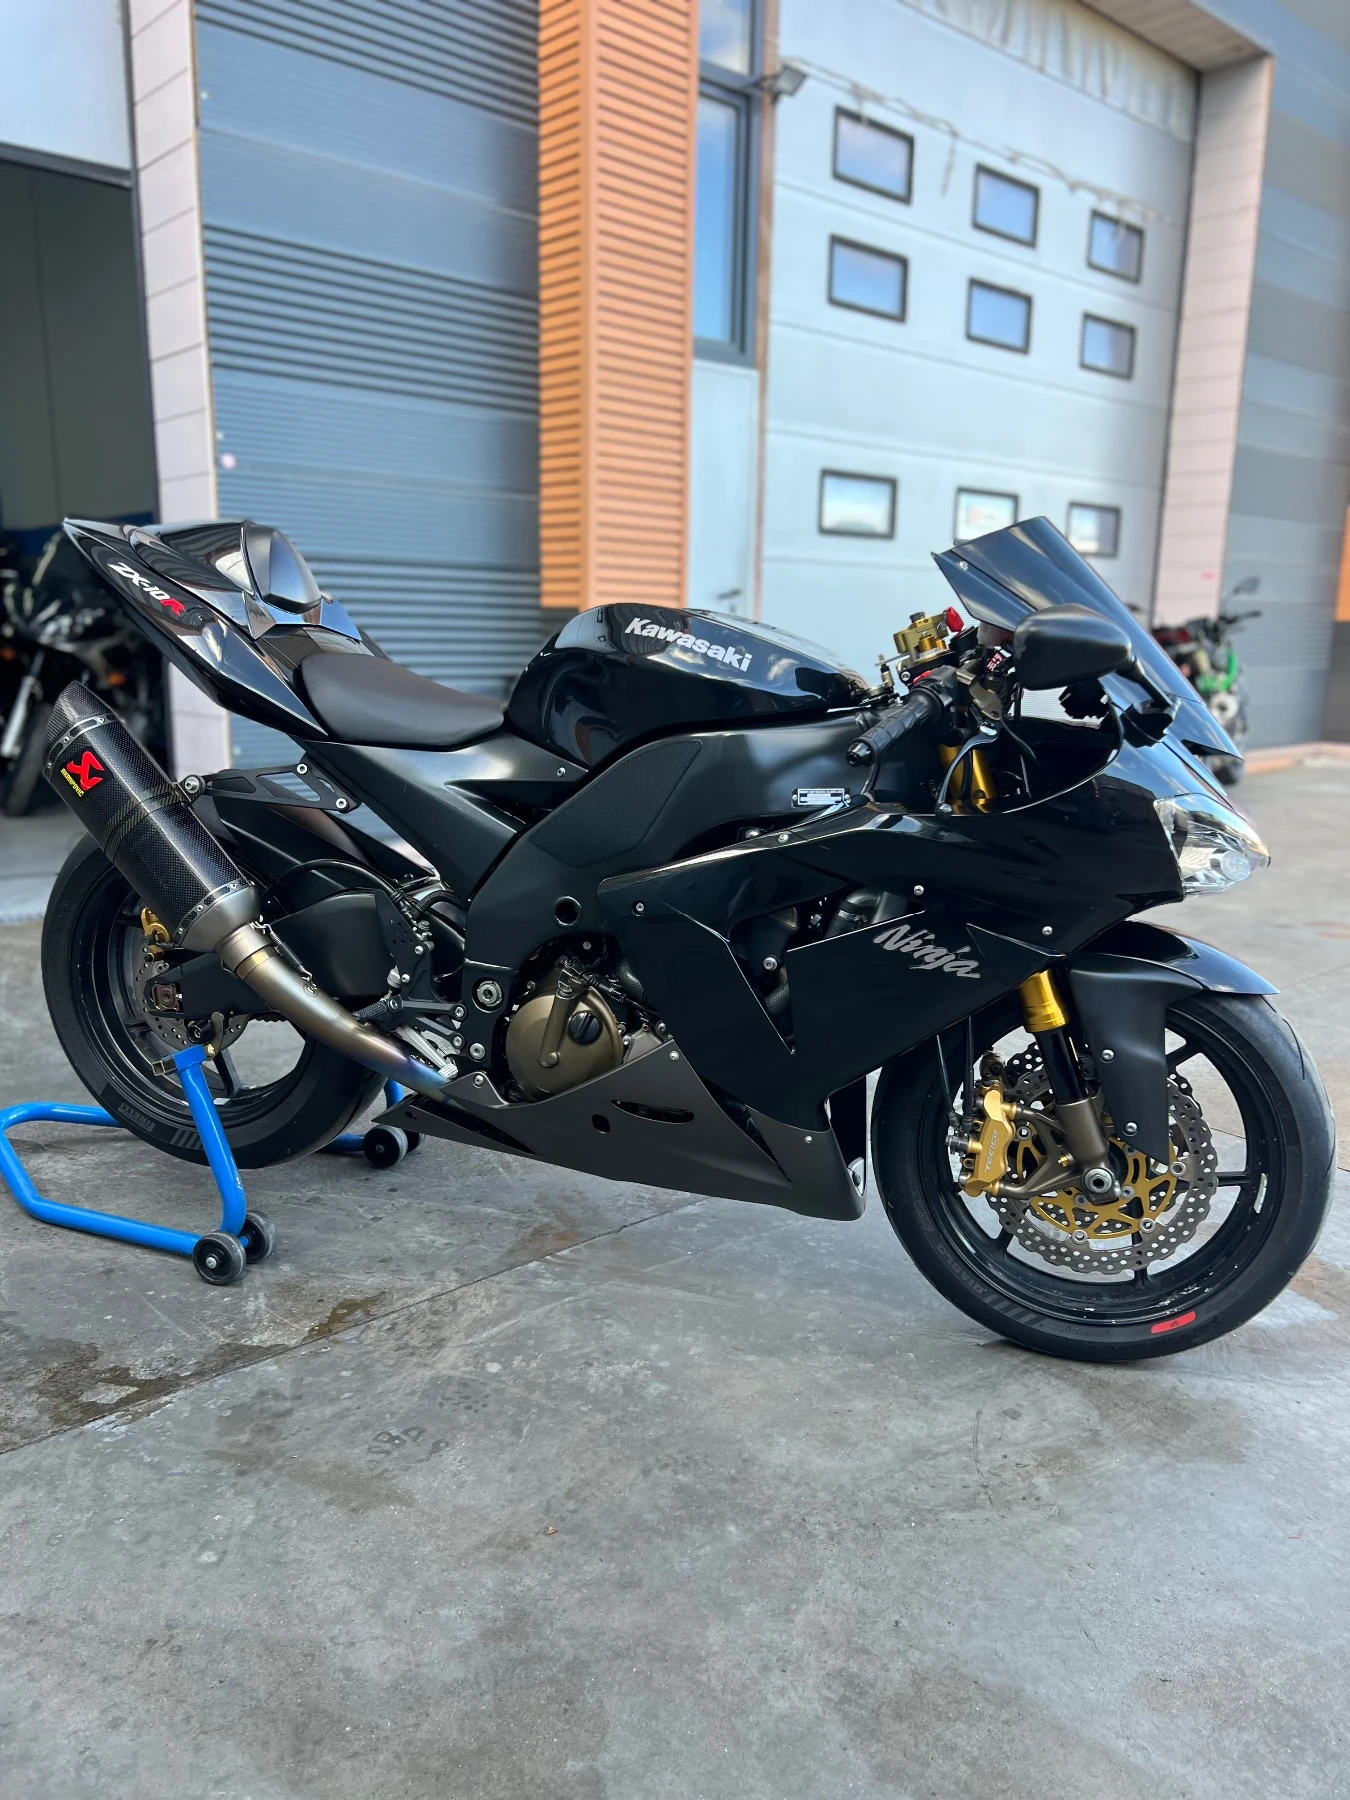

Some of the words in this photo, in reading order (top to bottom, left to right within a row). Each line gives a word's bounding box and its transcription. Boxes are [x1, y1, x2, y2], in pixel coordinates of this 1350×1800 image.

[108, 562, 185, 616] ZX-10R
[625, 617, 752, 672] Kawasaki
[873, 924, 980, 978] Ninja
[118, 1103, 155, 1132] PIRELLI
[937, 1244, 985, 1295] DIABLO
